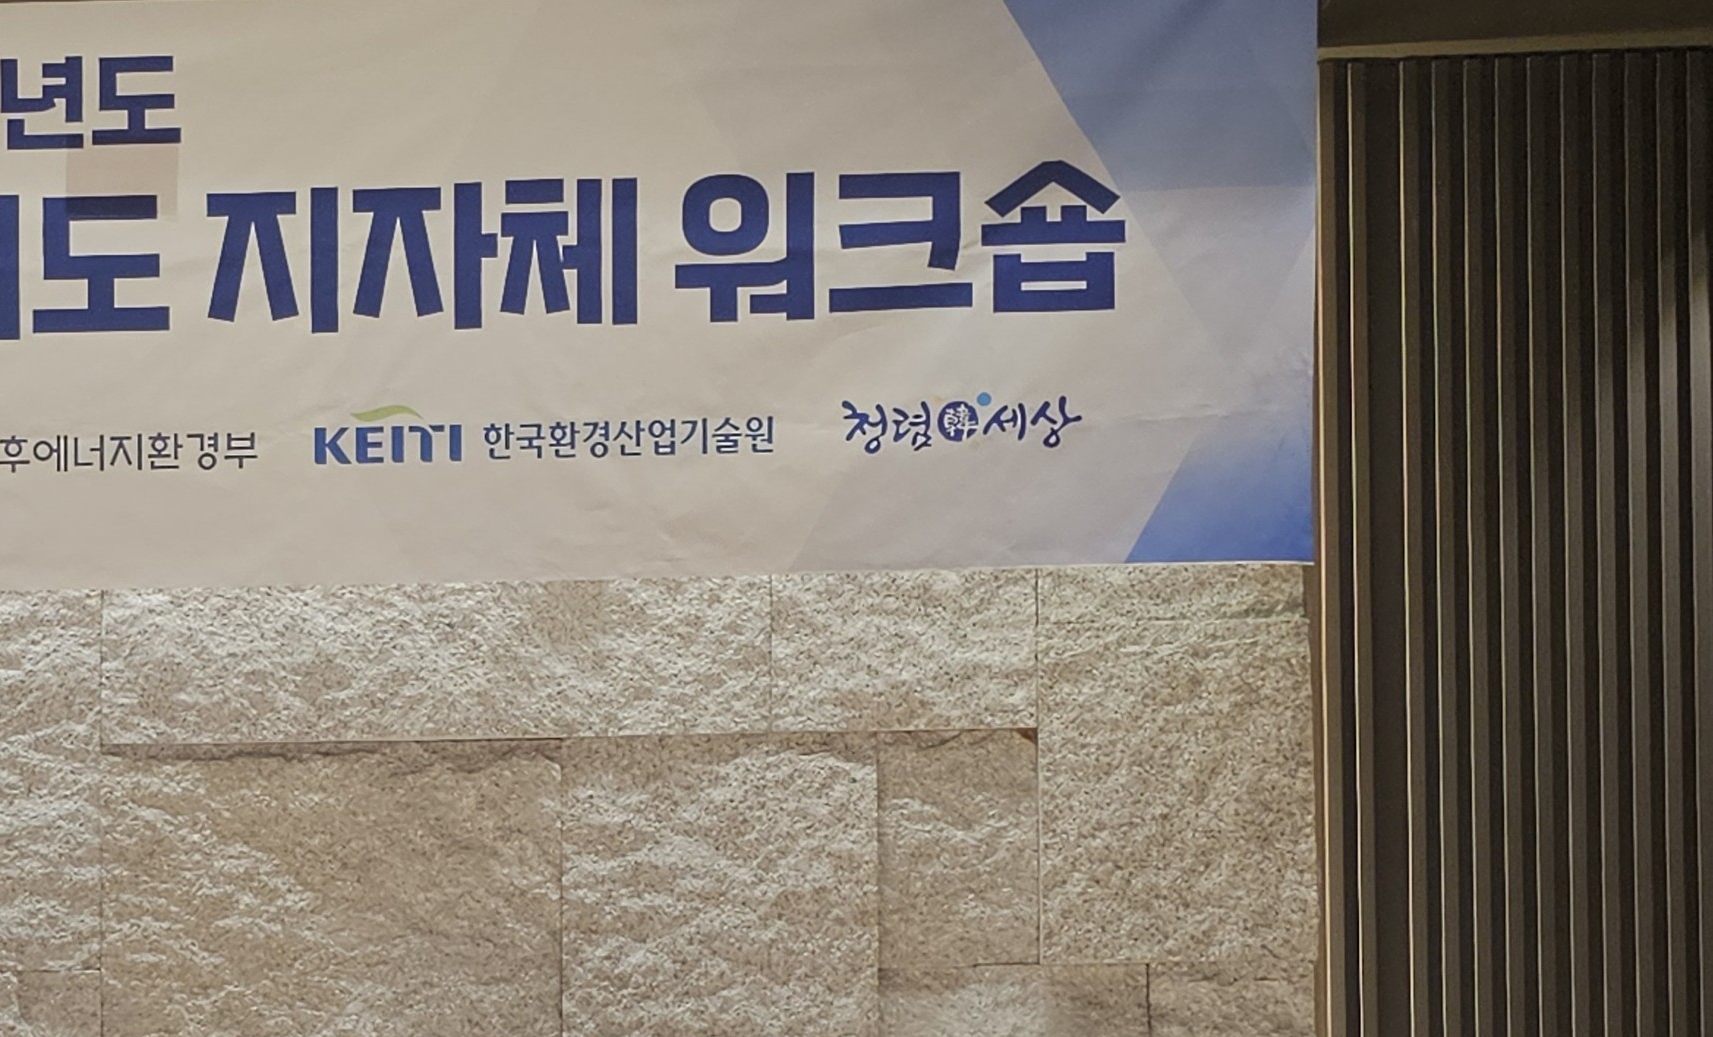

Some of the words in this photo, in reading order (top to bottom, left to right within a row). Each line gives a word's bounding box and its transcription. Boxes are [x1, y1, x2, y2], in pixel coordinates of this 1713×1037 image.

[206, 176, 638, 334] 지자체
[674, 159, 1126, 323] 워크숍
[314, 424, 462, 465] KEITI
[483, 416, 775, 460] 한국환경산업기술원
